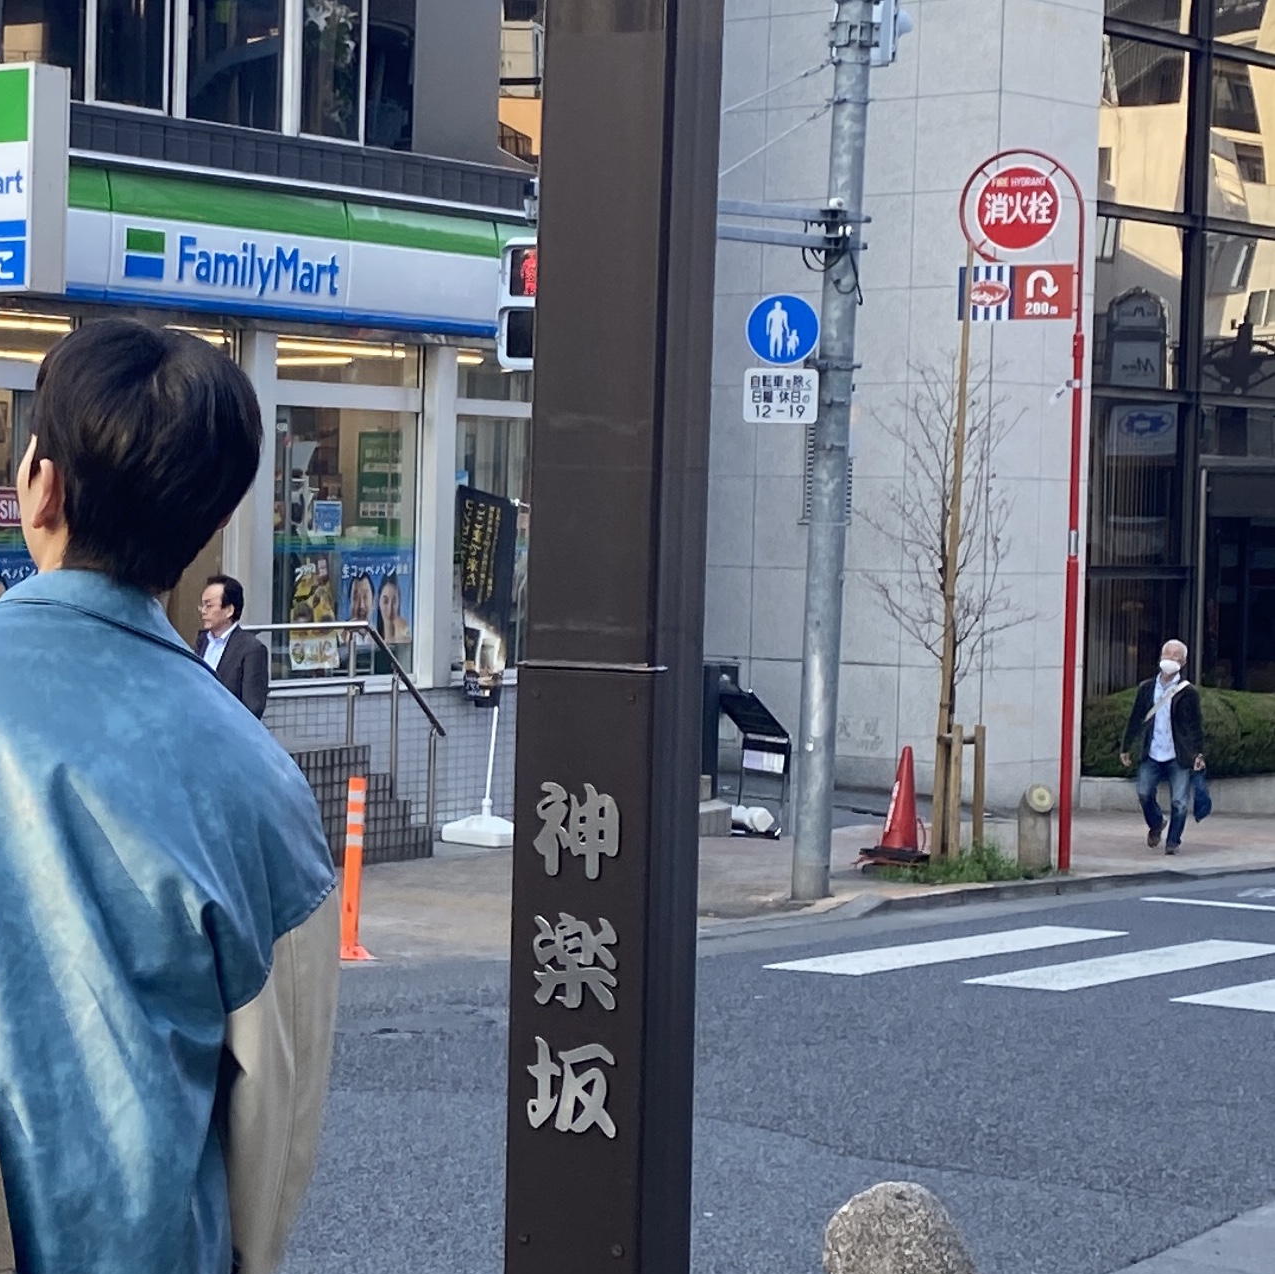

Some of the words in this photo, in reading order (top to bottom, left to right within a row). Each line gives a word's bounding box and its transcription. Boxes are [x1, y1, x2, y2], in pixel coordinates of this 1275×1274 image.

[984, 191, 1054, 225] 消火栓
[178, 235, 339, 297] FamilyMart
[526, 781, 619, 1138] 神楽坂
